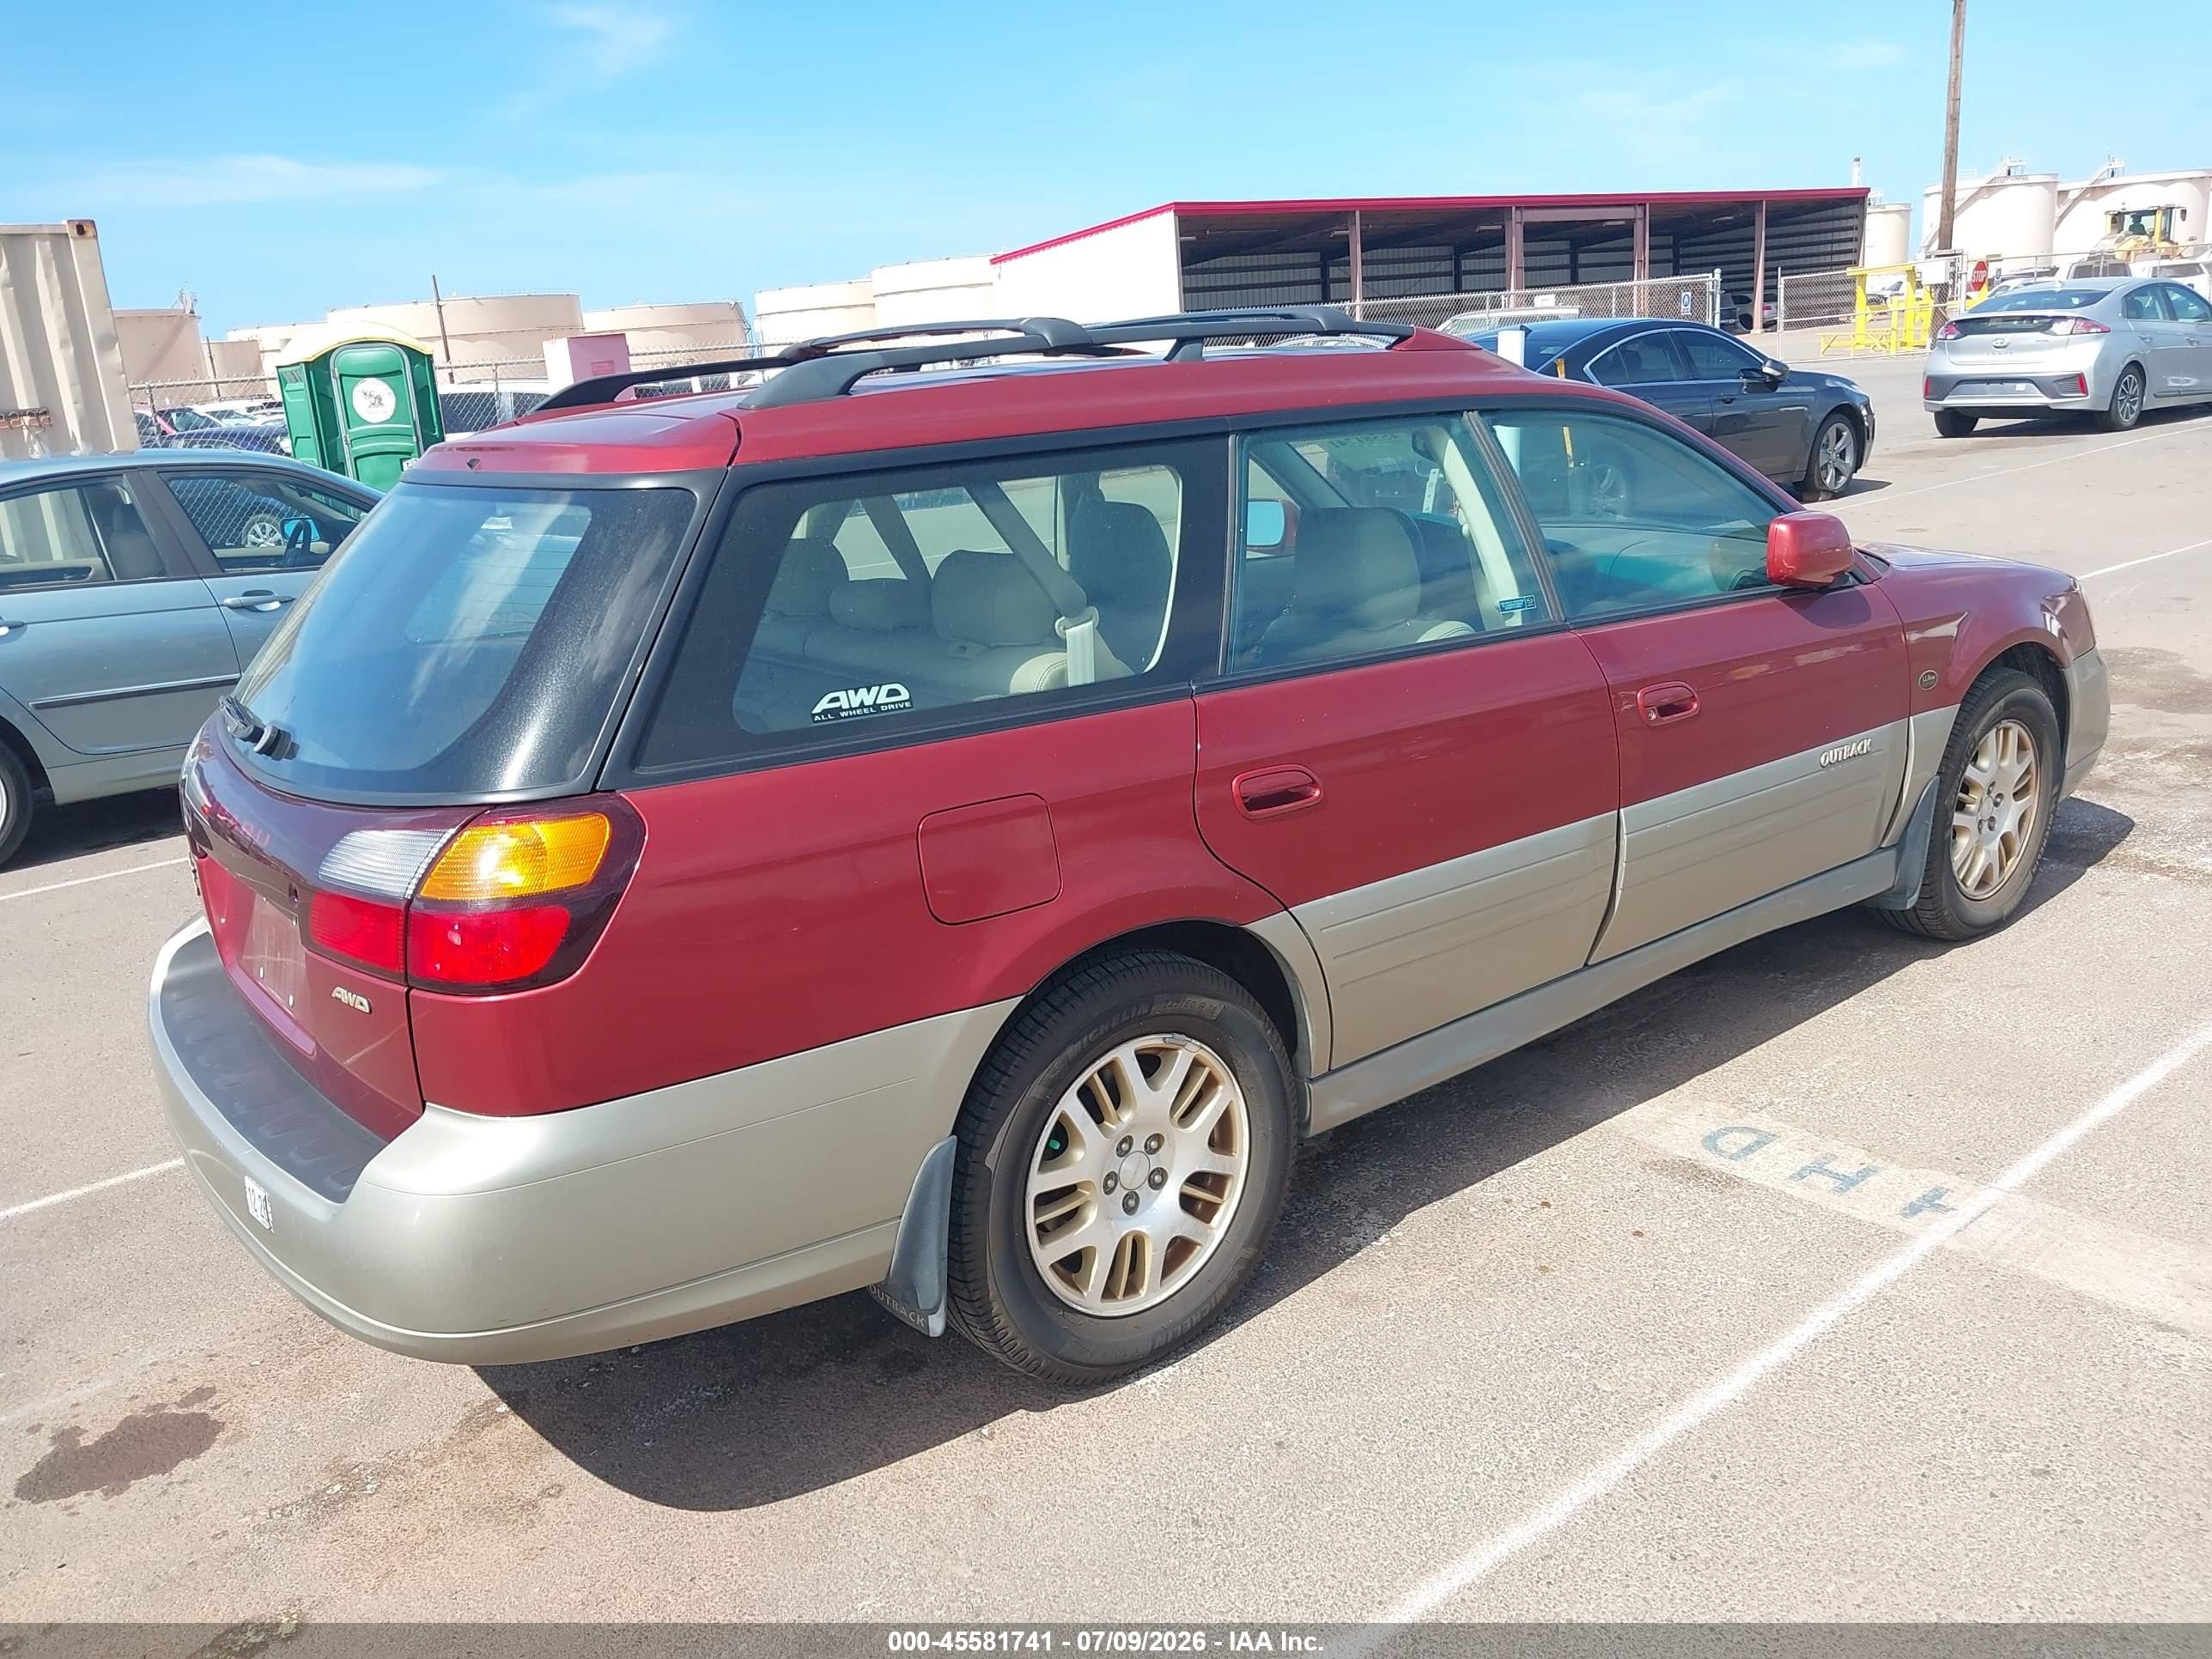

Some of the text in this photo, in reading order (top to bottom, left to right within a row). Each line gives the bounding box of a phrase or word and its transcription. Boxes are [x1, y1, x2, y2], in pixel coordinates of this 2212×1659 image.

[1972, 270, 1986, 282] STOP
[811, 684, 910, 714] AWD
[814, 702, 912, 722] ALL WHEEL DRIVE
[1820, 738, 1871, 767] OUTBACK
[331, 987, 370, 1013] AWD
[869, 1284, 925, 1328] OUTBACK
